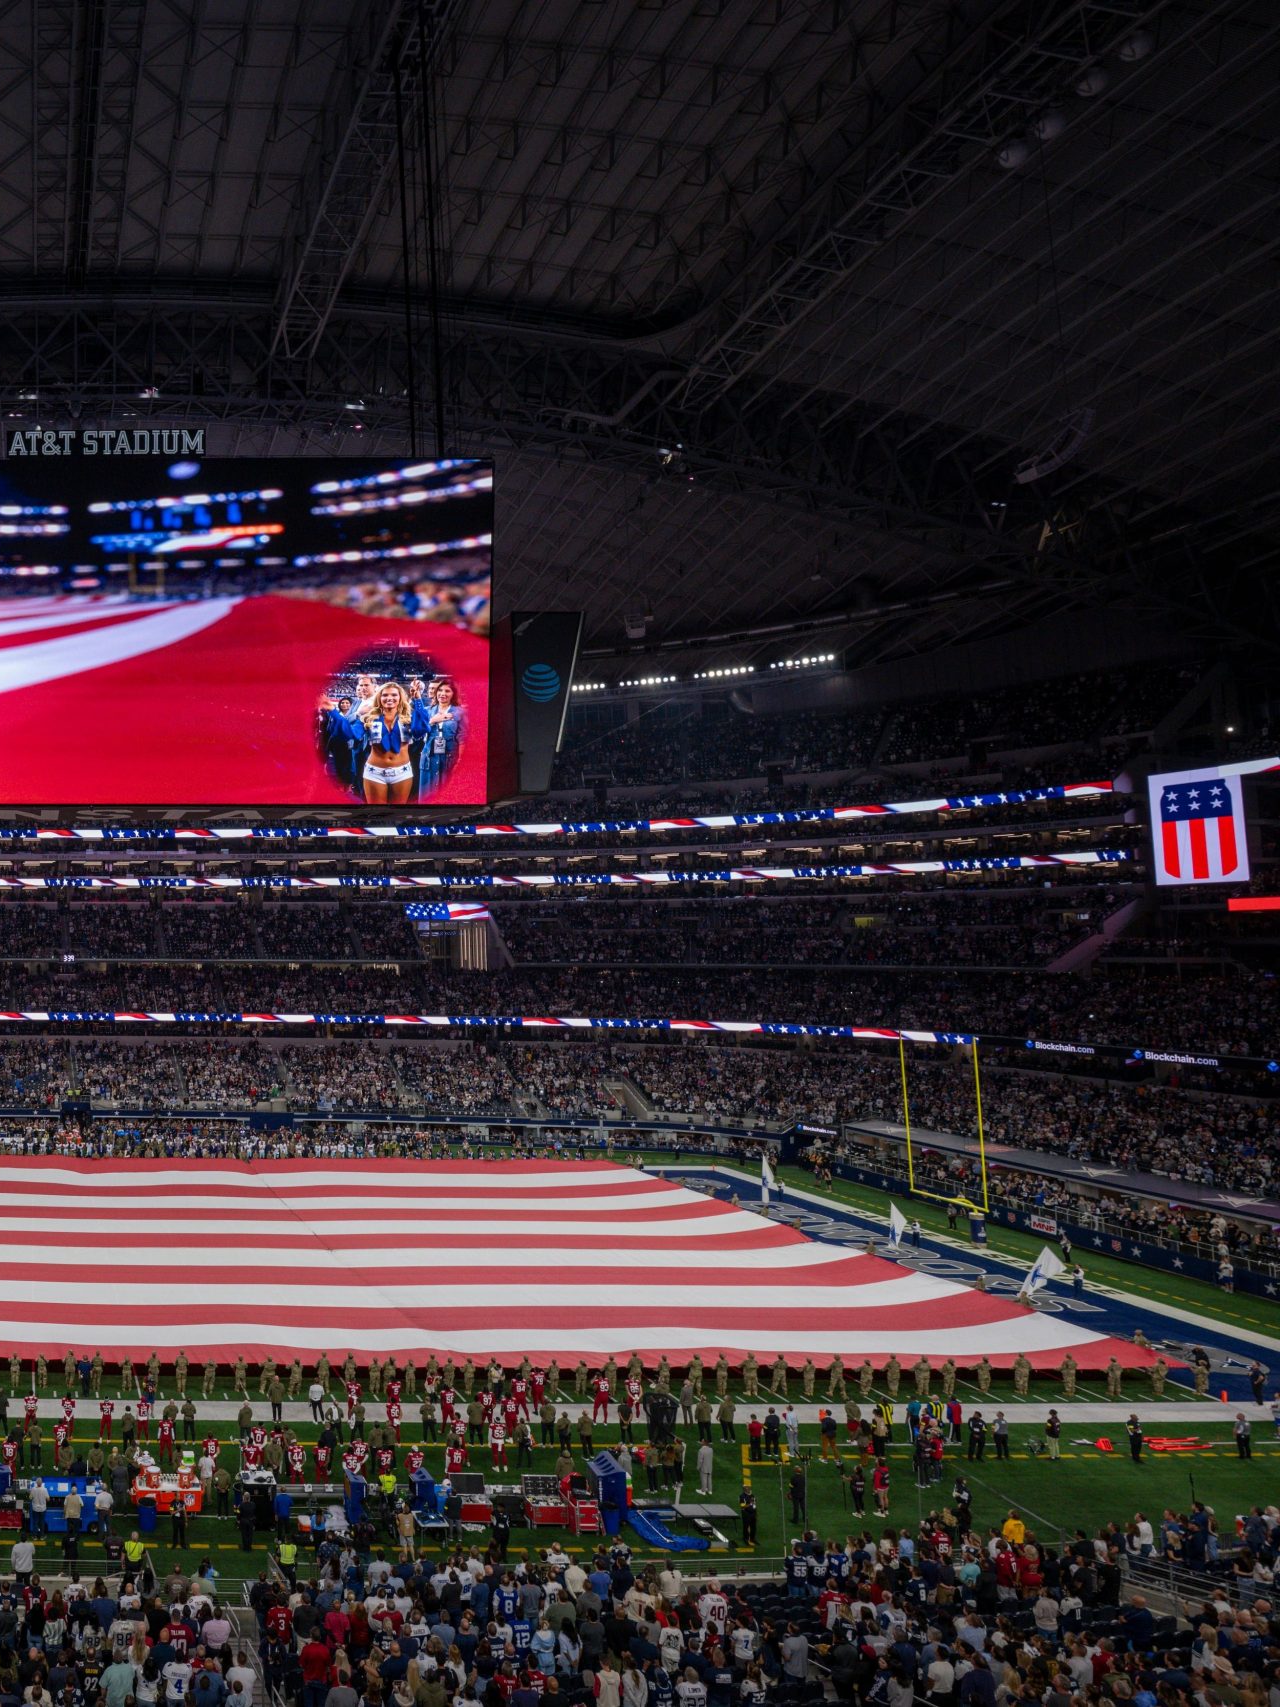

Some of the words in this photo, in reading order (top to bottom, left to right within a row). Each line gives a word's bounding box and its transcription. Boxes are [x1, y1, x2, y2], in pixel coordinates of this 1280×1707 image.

[8, 430, 76, 456] AT&T
[83, 429, 205, 455] STADIUM
[1035, 1041, 1095, 1055] Blockchain.com
[1144, 1051, 1219, 1067] Blockchain.com
[1032, 1221, 1056, 1233] MNF
[163, 1426, 170, 1435] 3
[710, 1606, 725, 1621] 40
[278, 1619, 286, 1631] 3
[514, 1632, 531, 1648] 12
[83, 1676, 99, 1692] 92
[173, 1679, 183, 1693] 4
